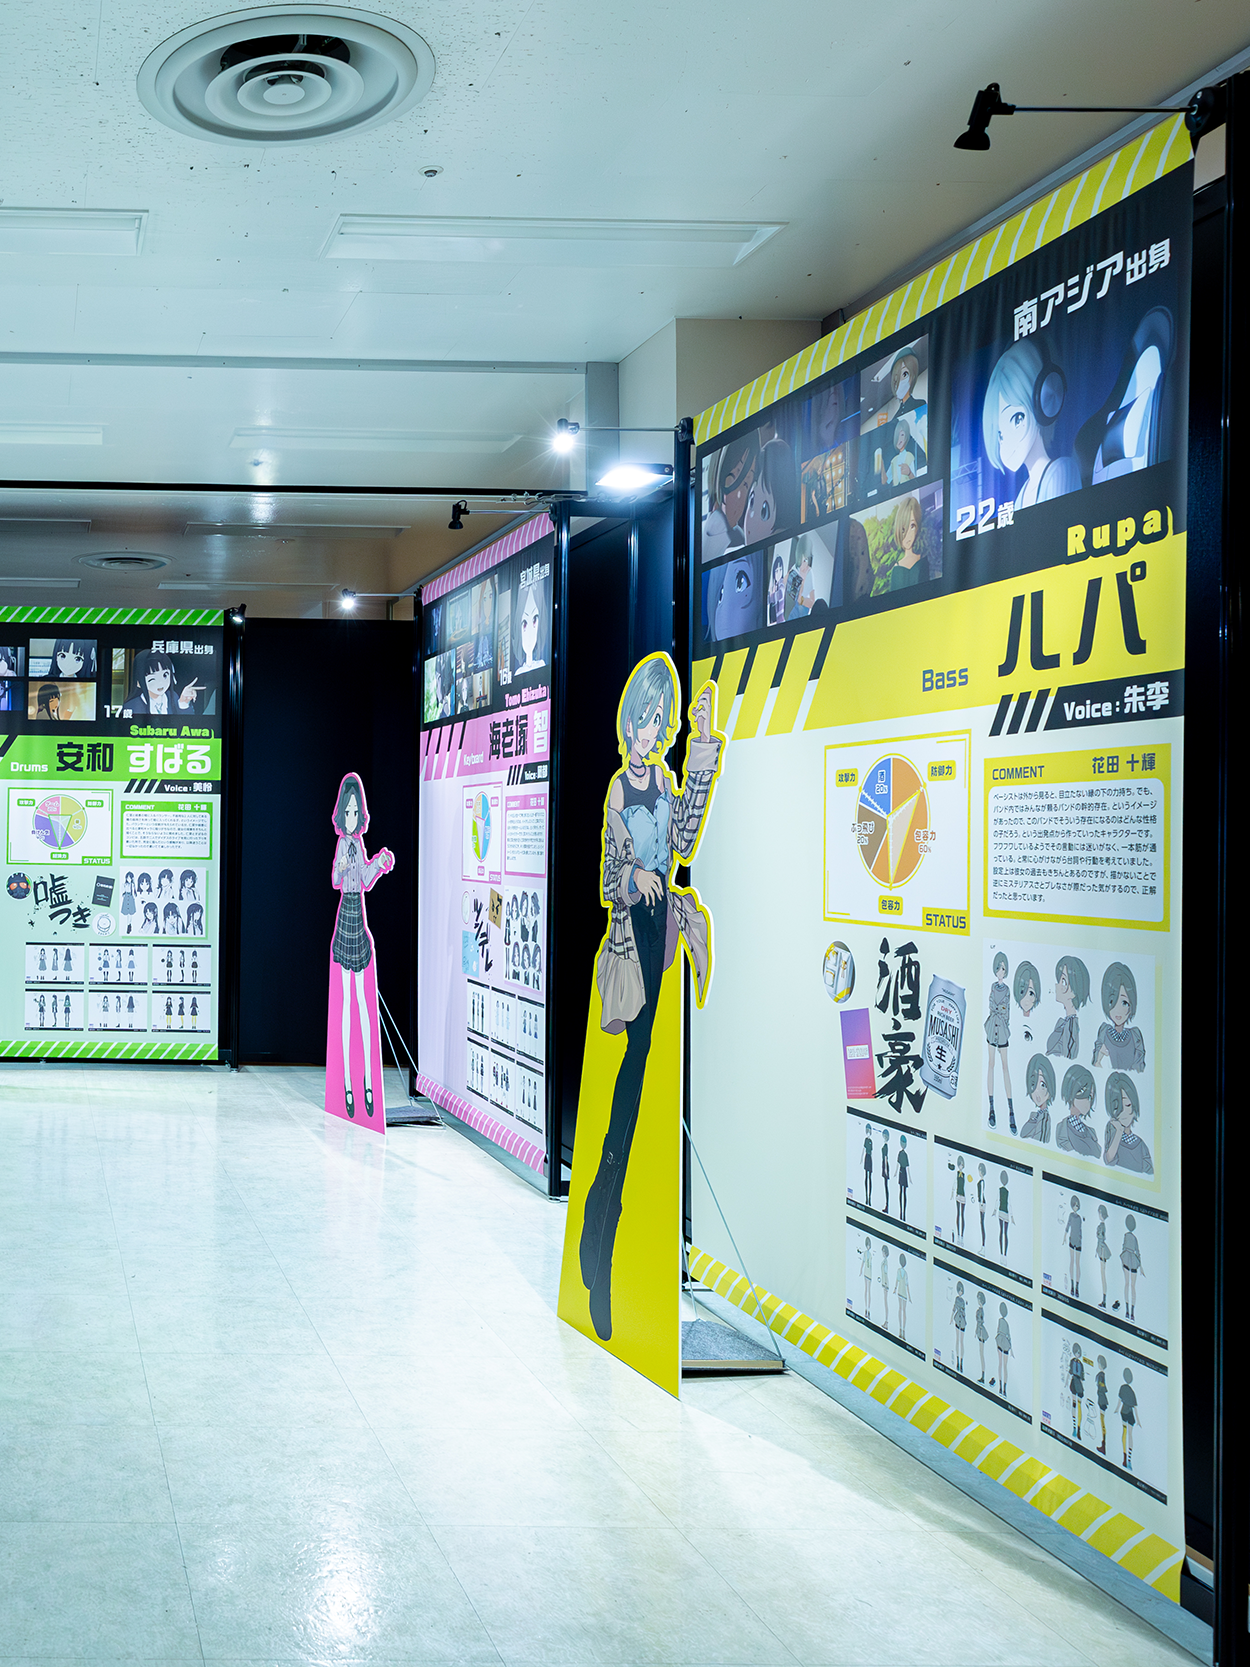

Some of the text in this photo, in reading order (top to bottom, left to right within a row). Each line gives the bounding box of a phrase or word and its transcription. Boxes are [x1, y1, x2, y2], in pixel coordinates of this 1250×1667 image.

[1013, 238, 1171, 342] 南アジア出身
[956, 498, 1014, 541] 22歳
[1067, 508, 1162, 557] Rupa
[998, 560, 1147, 678] ルパ
[151, 640, 214, 656] 兵庫県出身
[922, 667, 969, 692] Bass
[104, 705, 134, 719] 17歳
[130, 725, 210, 737] Subaru Awa
[489, 710, 549, 761] 海老塚 智
[56, 742, 212, 774] 安和 すばる
[1092, 752, 1156, 774] 花田 十輝
[10, 762, 49, 773] Drums
[930, 765, 953, 777] 防御力
[992, 765, 1045, 780] COMMENT
[838, 772, 856, 783] 攻撃力
[915, 830, 936, 841] 包容力
[881, 899, 901, 911] 包容力
[925, 913, 967, 929] STATUS
[941, 1005, 952, 1014] DRY
[871, 937, 929, 1113] 酒豪
[929, 1015, 960, 1051] MUSASHI
[935, 1045, 947, 1063] 生
